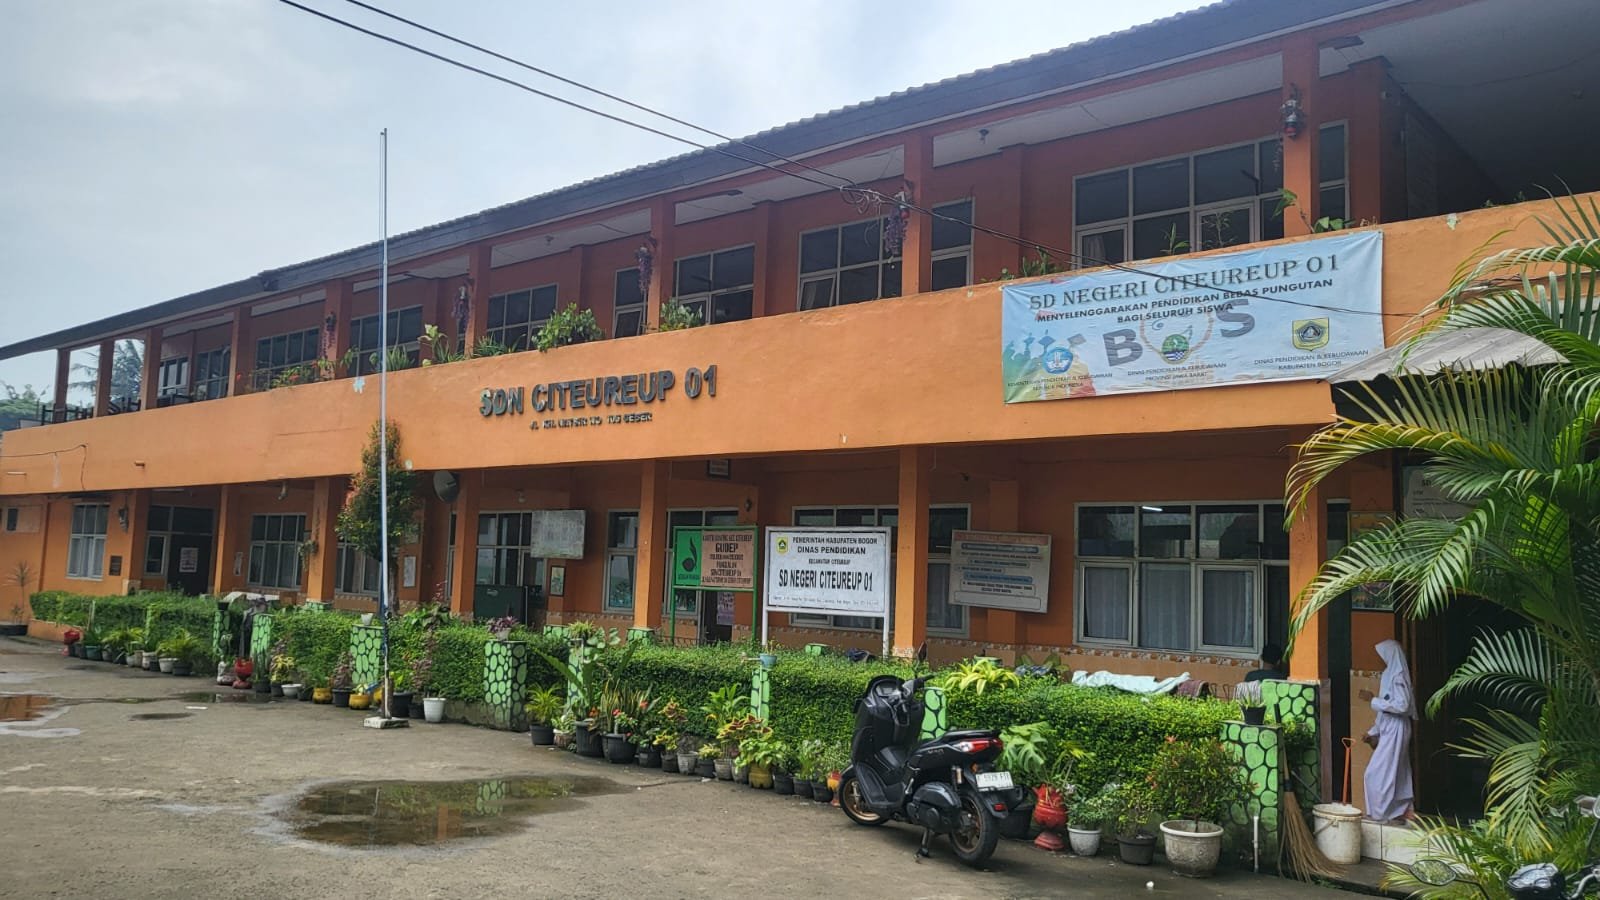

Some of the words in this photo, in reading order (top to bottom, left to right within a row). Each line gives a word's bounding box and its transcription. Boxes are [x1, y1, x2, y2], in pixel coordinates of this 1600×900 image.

[1030, 294, 1056, 310] SD
[1062, 280, 1148, 306] NEGERI
[1154, 260, 1298, 294] CITEUREUP
[1037, 301, 1149, 322] MENYELENGGARAKAN
[1151, 293, 1220, 308] PENDIDIKAN
[1223, 287, 1259, 300] BEBAS
[1262, 279, 1334, 295] PUNGUTAN
[1117, 314, 1142, 323] BAGI
[1145, 307, 1193, 320] SELURUH
[1197, 303, 1234, 314] SISWA
[1275, 355, 1315, 363] PENDIDIKAN
[1323, 349, 1369, 360] KEBUDAYAAN
[479, 387, 525, 417] SDN
[531, 369, 676, 413] CITEUREUP
[684, 364, 718, 399] 01
[793, 536, 825, 544] PEMERINTAH
[826, 537, 856, 545] KABUPATEN
[858, 537, 878, 545] BOGOR
[797, 546, 819, 554] DINAS
[821, 547, 866, 555] PENDIDIKAN
[779, 569, 789, 587] SD
[790, 569, 817, 588] NEGERI
[820, 571, 862, 591] CITEUREUP
[864, 572, 873, 592] 01
